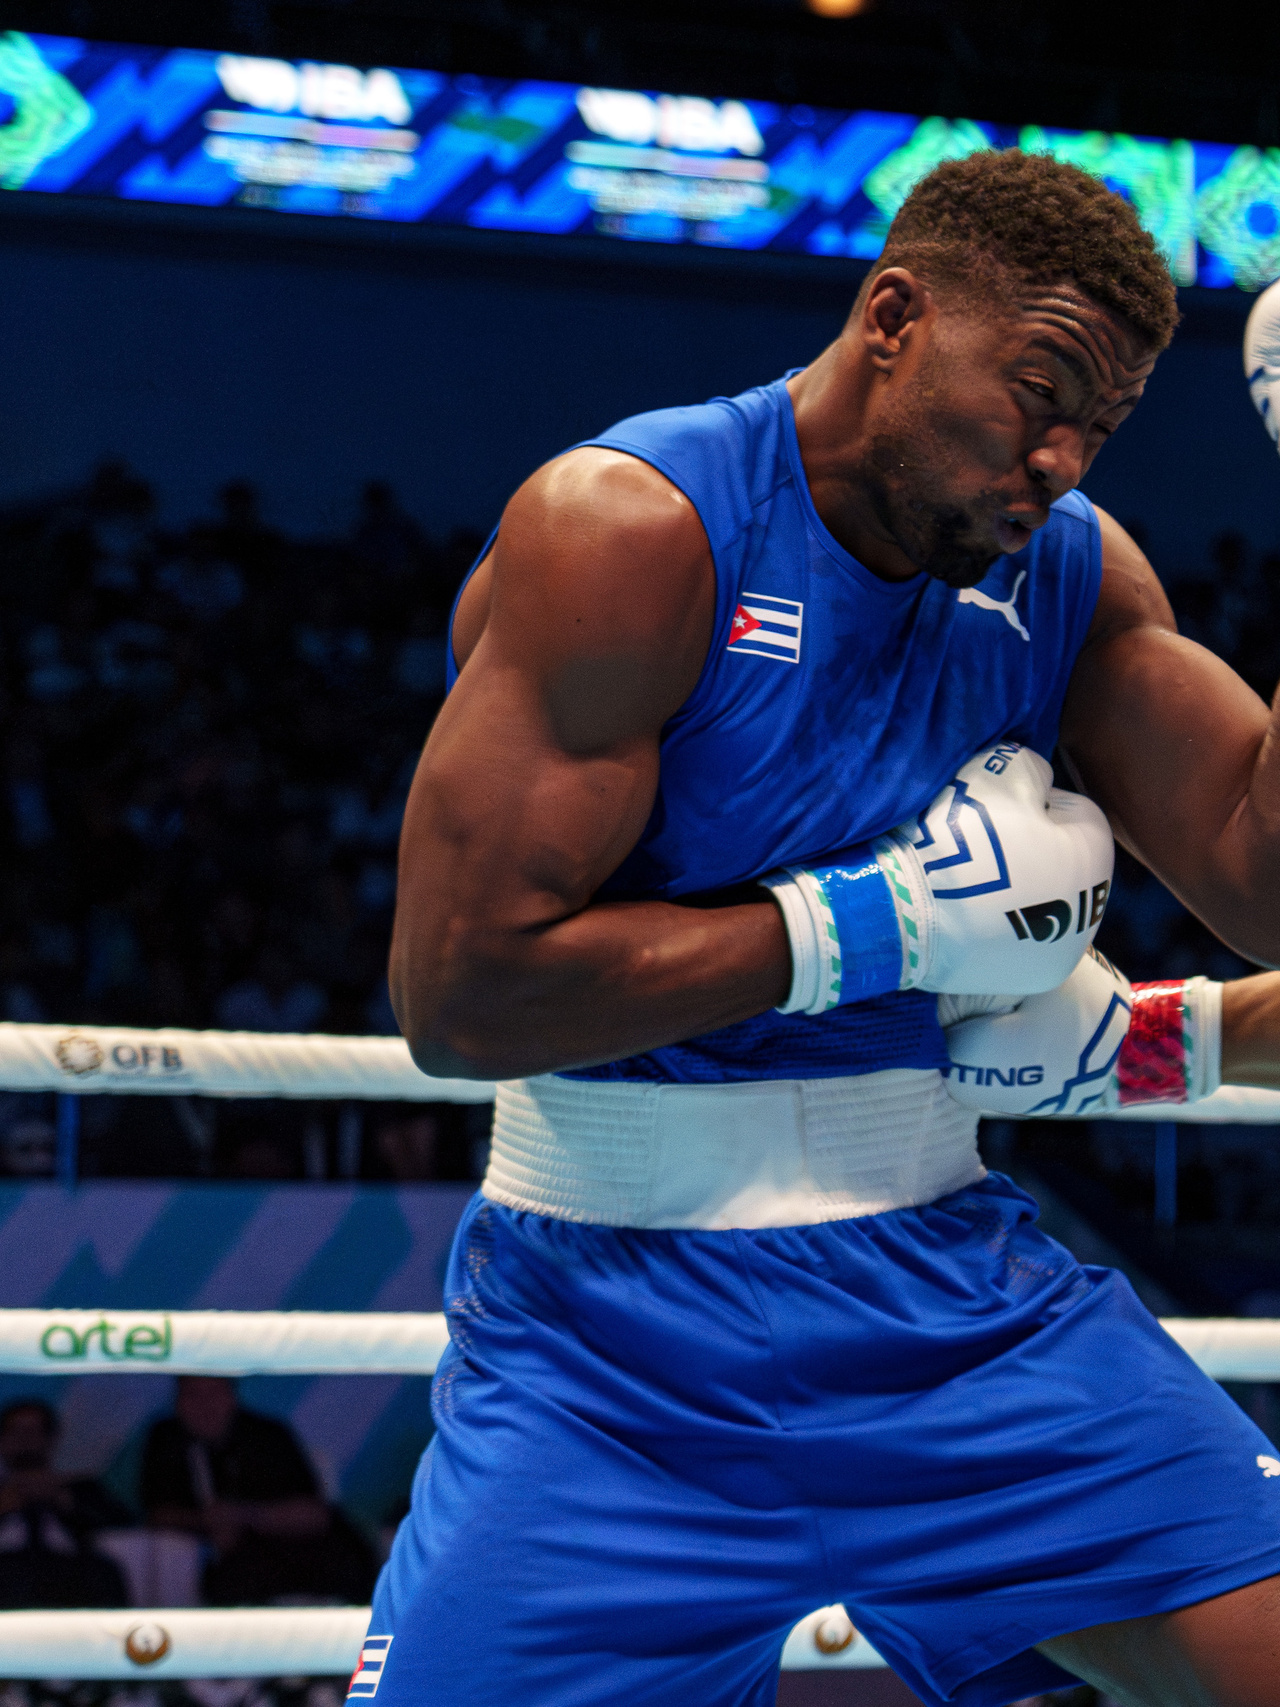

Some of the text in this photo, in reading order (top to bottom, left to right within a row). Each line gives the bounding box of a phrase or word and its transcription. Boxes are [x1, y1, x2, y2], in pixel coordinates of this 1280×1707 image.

[112, 1044, 183, 1071] OFB
[955, 1064, 1044, 1087] TING
[42, 1313, 171, 1361] artel
